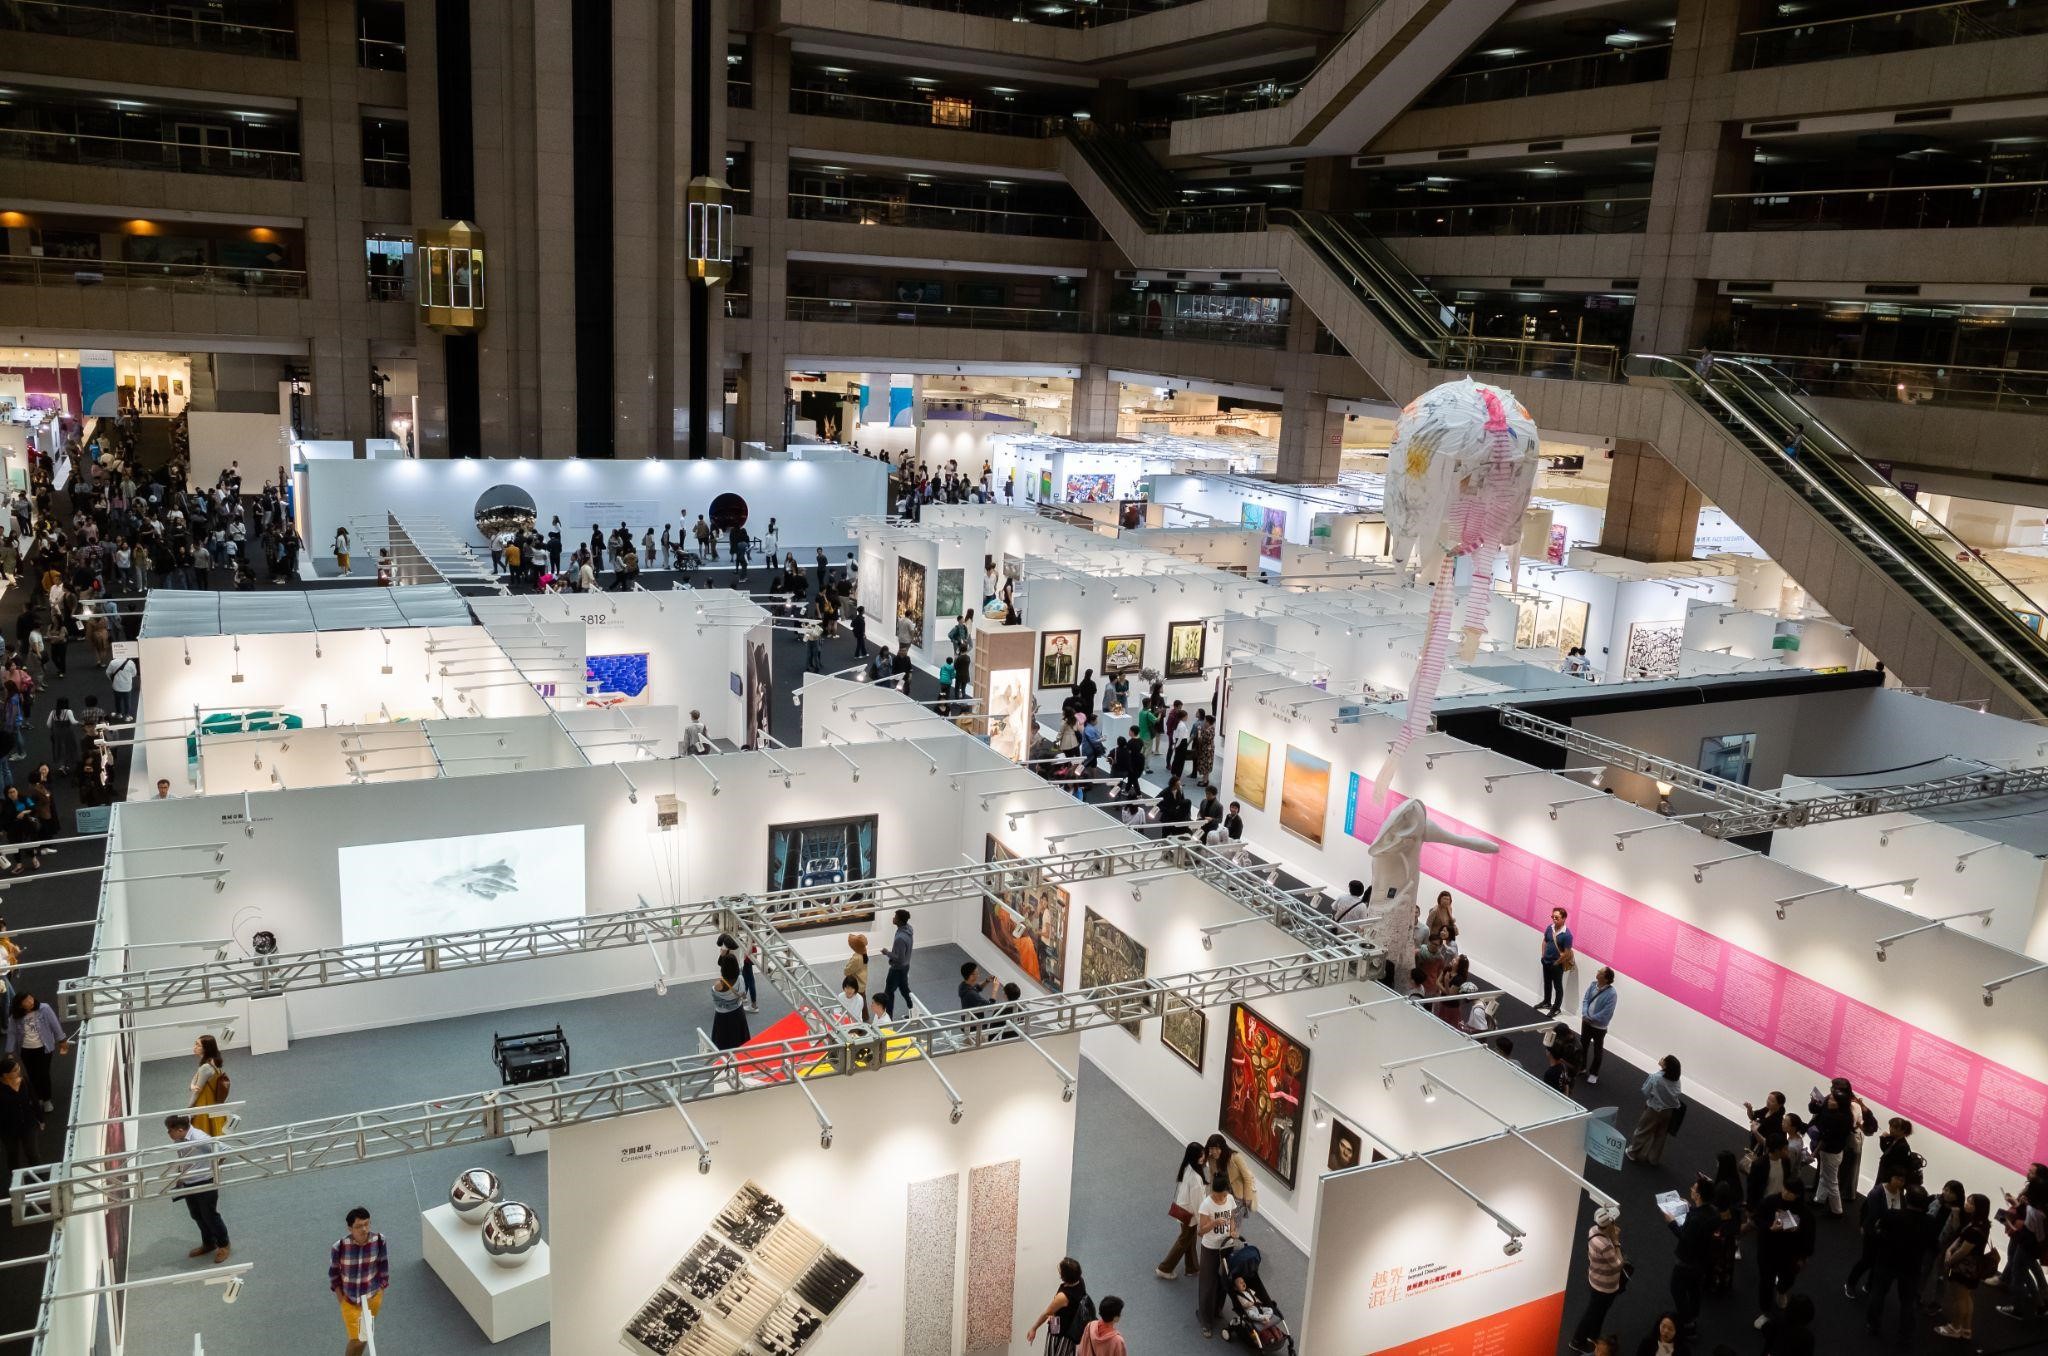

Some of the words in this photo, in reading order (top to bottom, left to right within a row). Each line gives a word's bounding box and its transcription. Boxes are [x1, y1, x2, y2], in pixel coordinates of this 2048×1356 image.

[580, 614, 606, 624] 3812
[621, 1144, 651, 1155] 空間越界
[1605, 1135, 1622, 1150] Y03
[621, 1152, 653, 1163] Crossing
[654, 1146, 679, 1157] Spatial
[1371, 1265, 1403, 1289] 越界
